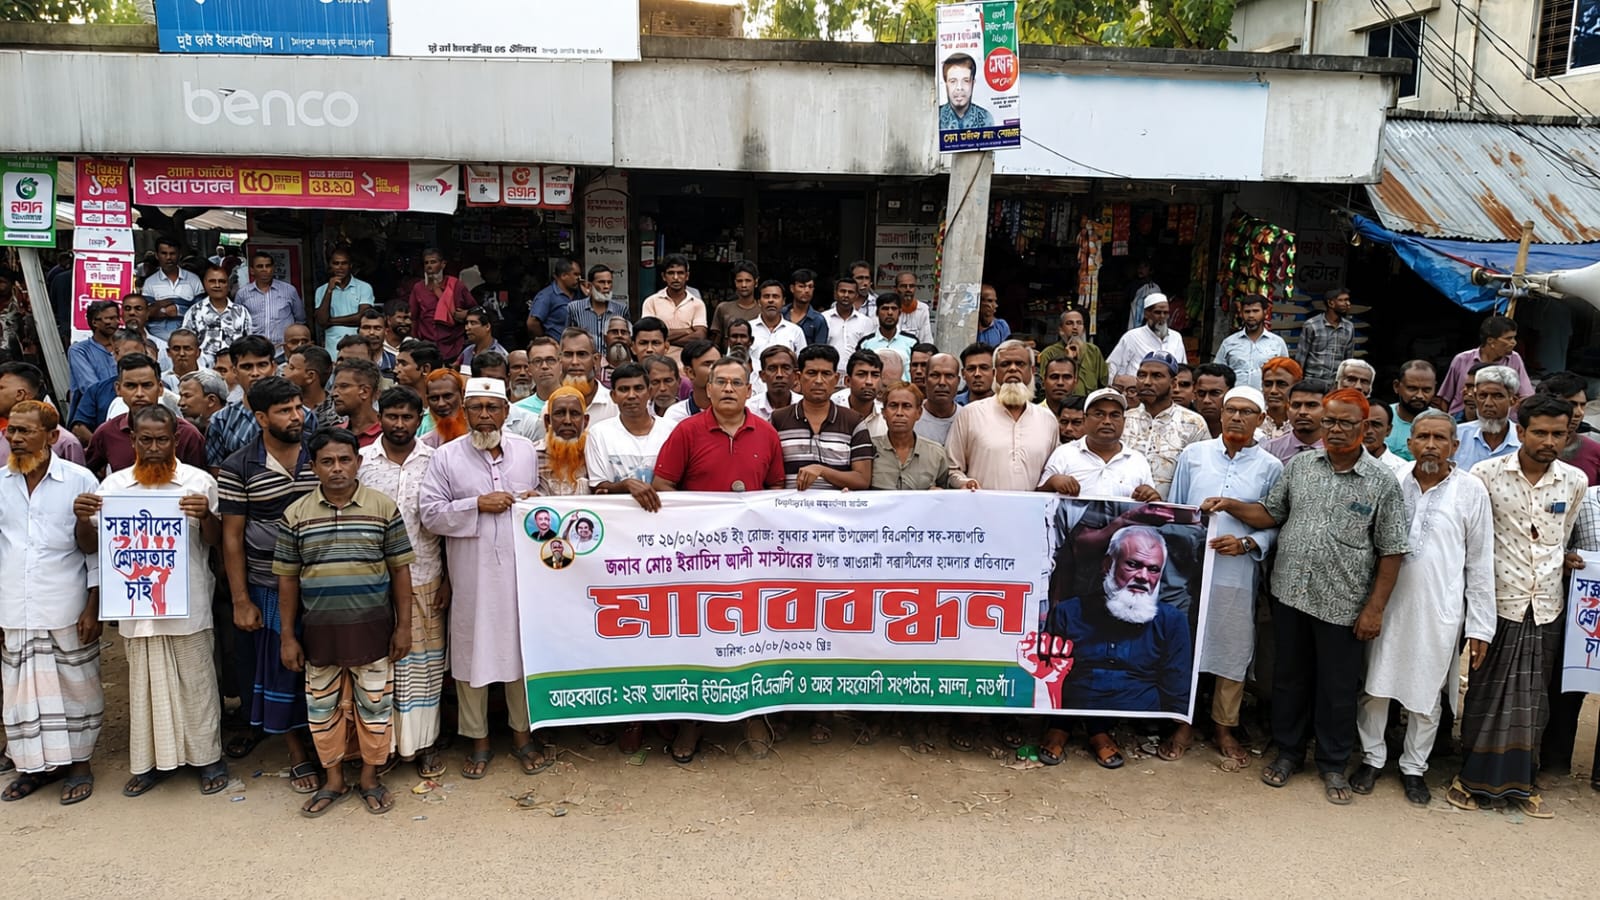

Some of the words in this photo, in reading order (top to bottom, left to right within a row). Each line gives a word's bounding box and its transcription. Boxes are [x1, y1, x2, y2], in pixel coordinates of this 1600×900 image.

[183, 81, 359, 128] benco
[604, 556, 642, 576] জনাব
[125, 576, 153, 601] চাই
[587, 580, 1035, 645] মানববন্ধন
